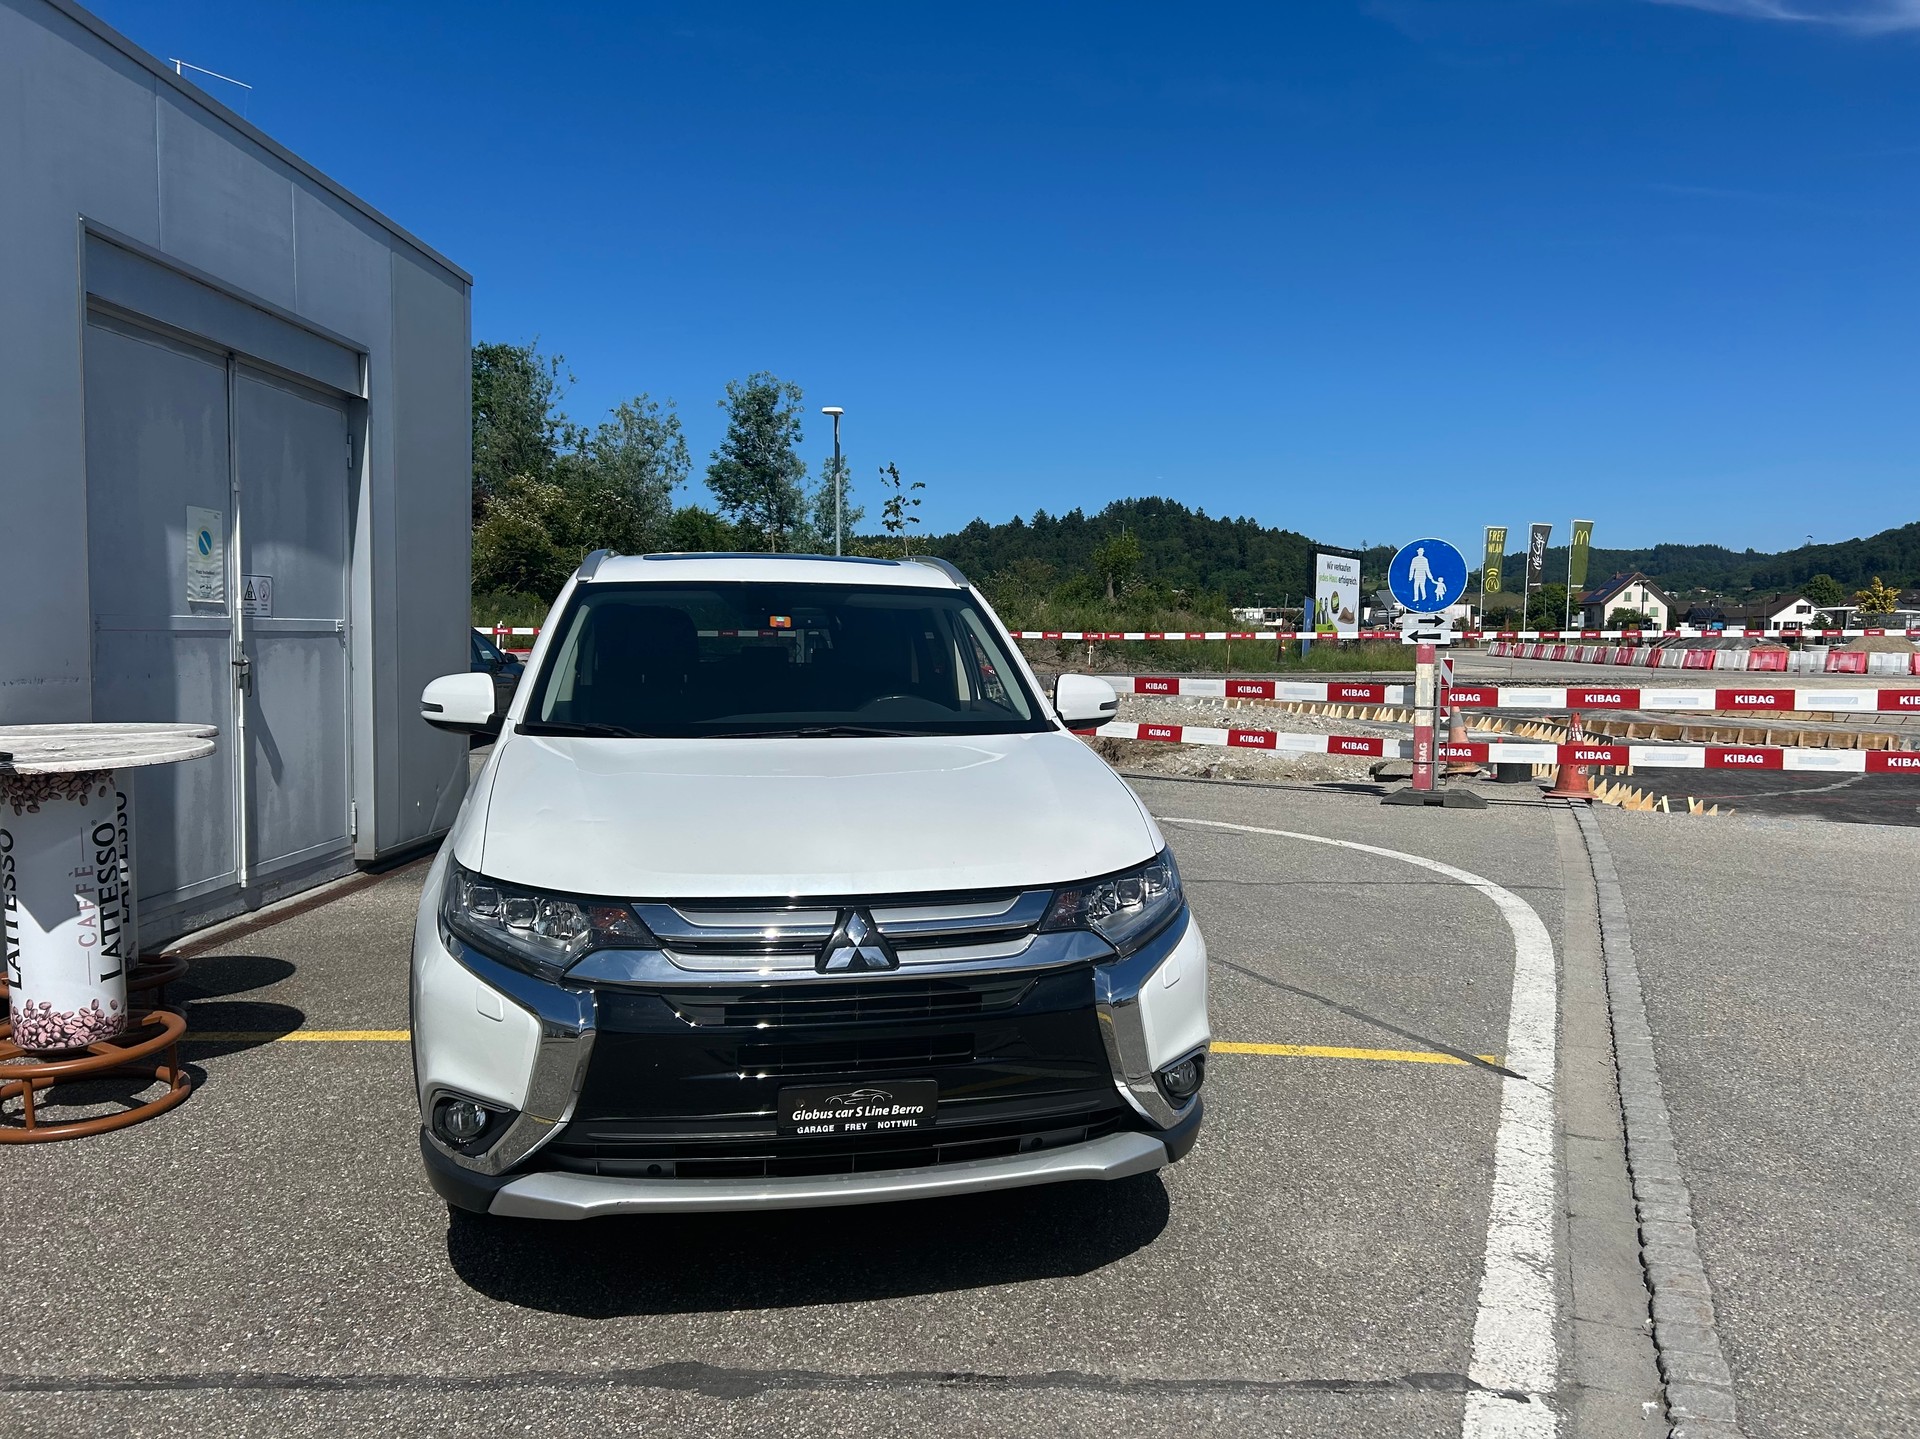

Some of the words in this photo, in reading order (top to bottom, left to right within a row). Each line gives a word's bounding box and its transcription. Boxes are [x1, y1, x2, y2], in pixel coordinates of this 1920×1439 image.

[1488, 530, 1505, 541] FREE
[1487, 543, 1502, 553] WLAN
[1145, 682, 1168, 691] KIBAG
[1237, 685, 1263, 694] KIBAG
[1341, 688, 1370, 698] KIBAG
[1449, 693, 1481, 702] KIBAG
[1584, 694, 1621, 703] KIBAG
[1734, 694, 1775, 705] KIBAG
[1148, 728, 1171, 738] KIBAG
[1239, 734, 1265, 744] KIBAG
[1341, 741, 1369, 751] KIBAG
[1438, 748, 1472, 757] KIBAG
[1575, 750, 1611, 760] KIBAG
[1724, 753, 1764, 764] KIBAG
[69, 864, 97, 948] CAFFÈ
[92, 822, 123, 983] LATTESSO
[792, 1108, 833, 1121] Globus
[835, 1108, 854, 1118] car
[855, 1106, 863, 1117] S
[865, 1105, 890, 1117] Line
[891, 1104, 924, 1116] Berro
[797, 1124, 835, 1134] GARAGE
[845, 1122, 868, 1131] FREY
[877, 1119, 918, 1129] NOTTWIL
